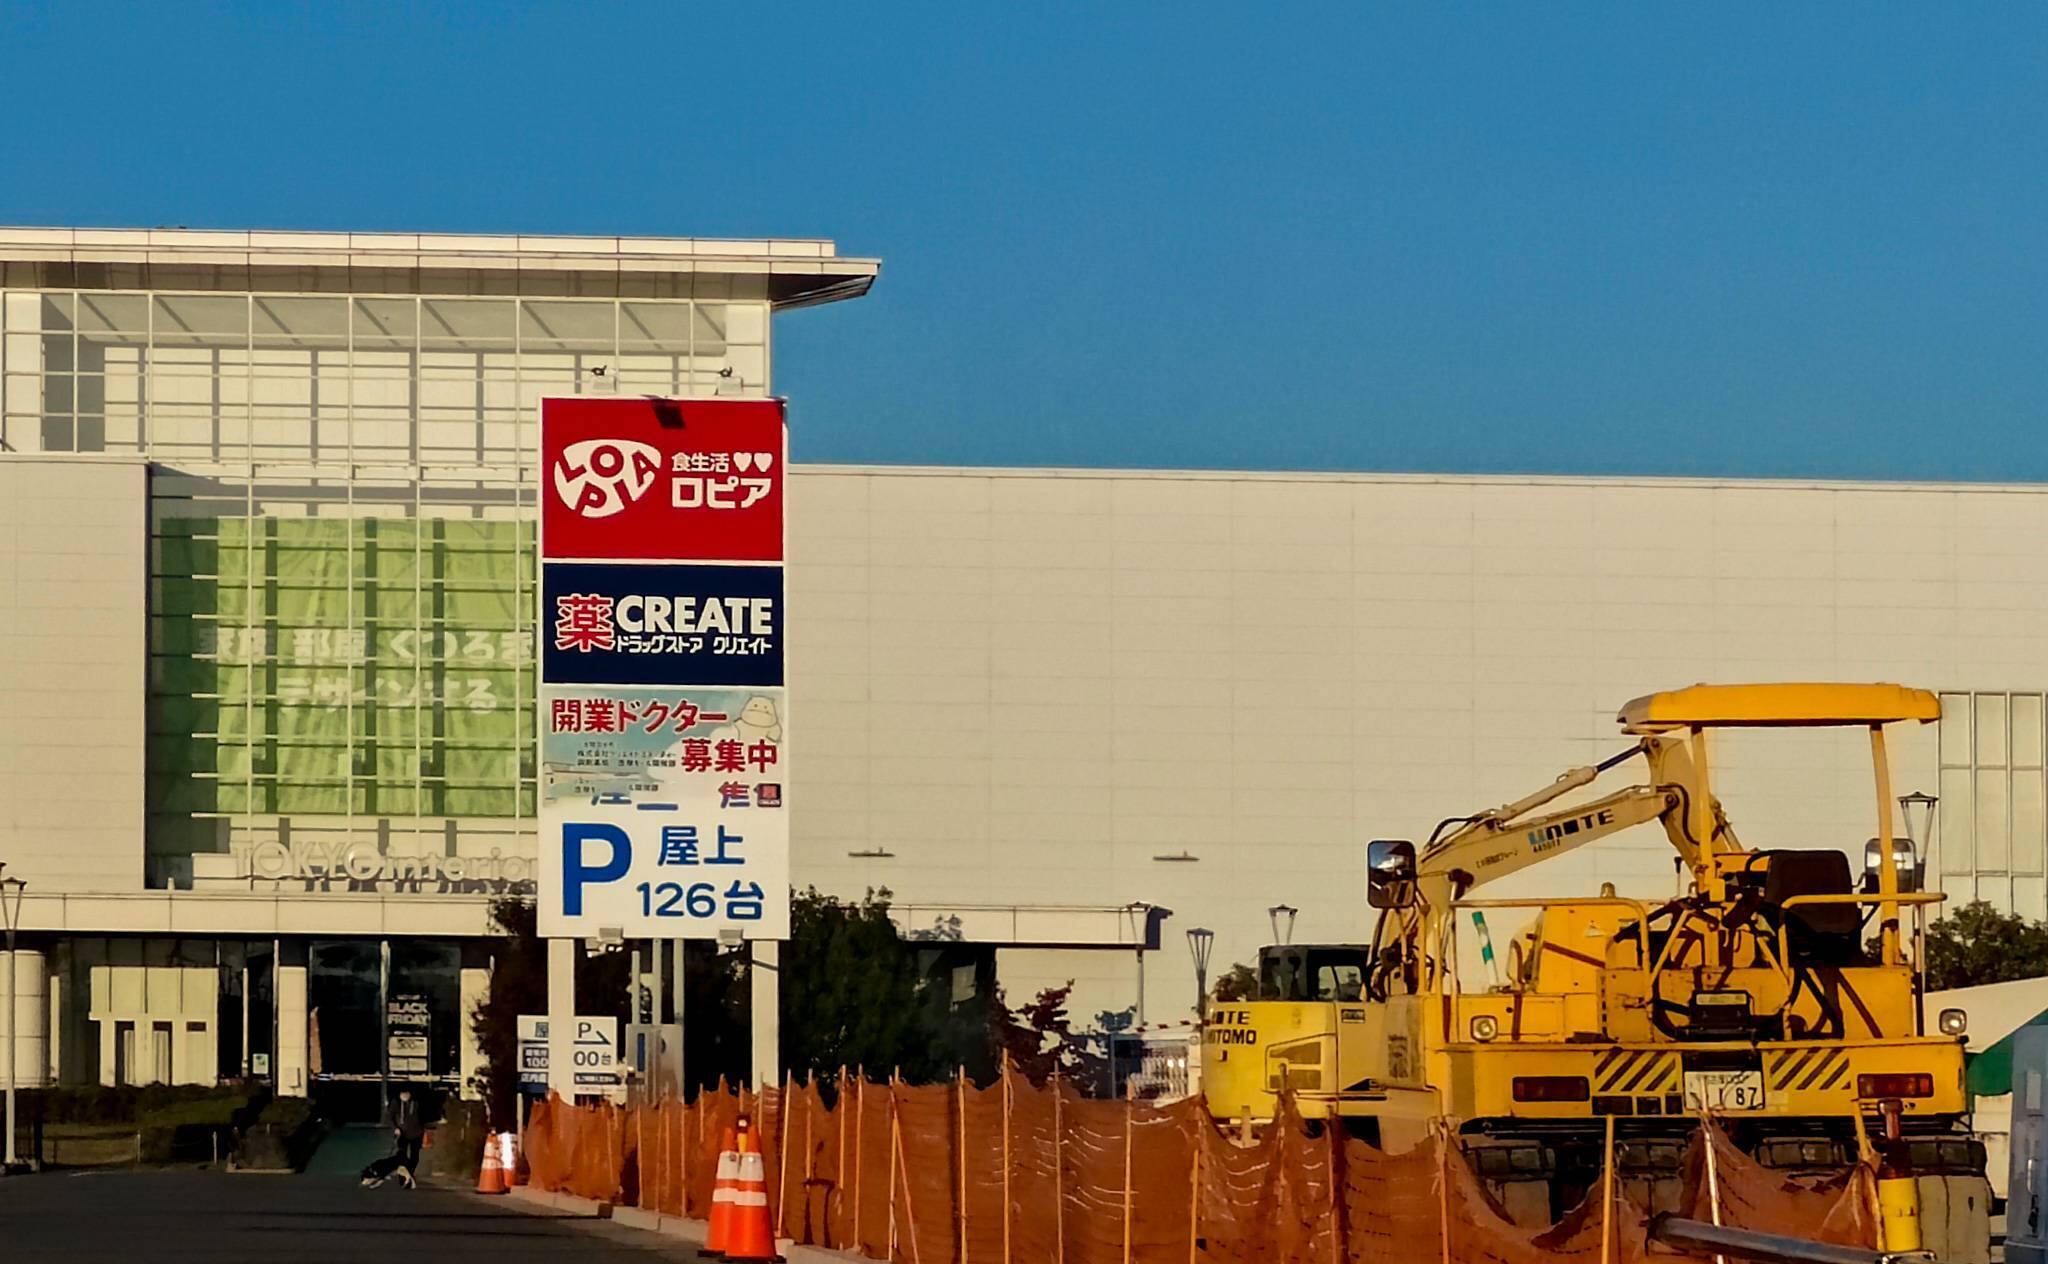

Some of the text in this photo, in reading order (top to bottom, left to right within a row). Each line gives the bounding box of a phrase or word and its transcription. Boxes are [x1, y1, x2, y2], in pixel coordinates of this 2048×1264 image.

[672, 452, 730, 473] 食生活
[671, 475, 772, 509] ロピア
[555, 593, 773, 653] 薬 CREATE
[616, 635, 773, 655] ドラッグストア クリエイト
[551, 697, 728, 733] 開業ドクター
[681, 737, 778, 773] 募集中
[230, 840, 382, 880] TOKYO
[562, 822, 745, 917] P 屋上
[637, 879, 765, 920] 126台
[388, 1002, 428, 1013] BLACK
[388, 1014, 428, 1026] FRIDAY
[578, 1022, 591, 1038] P
